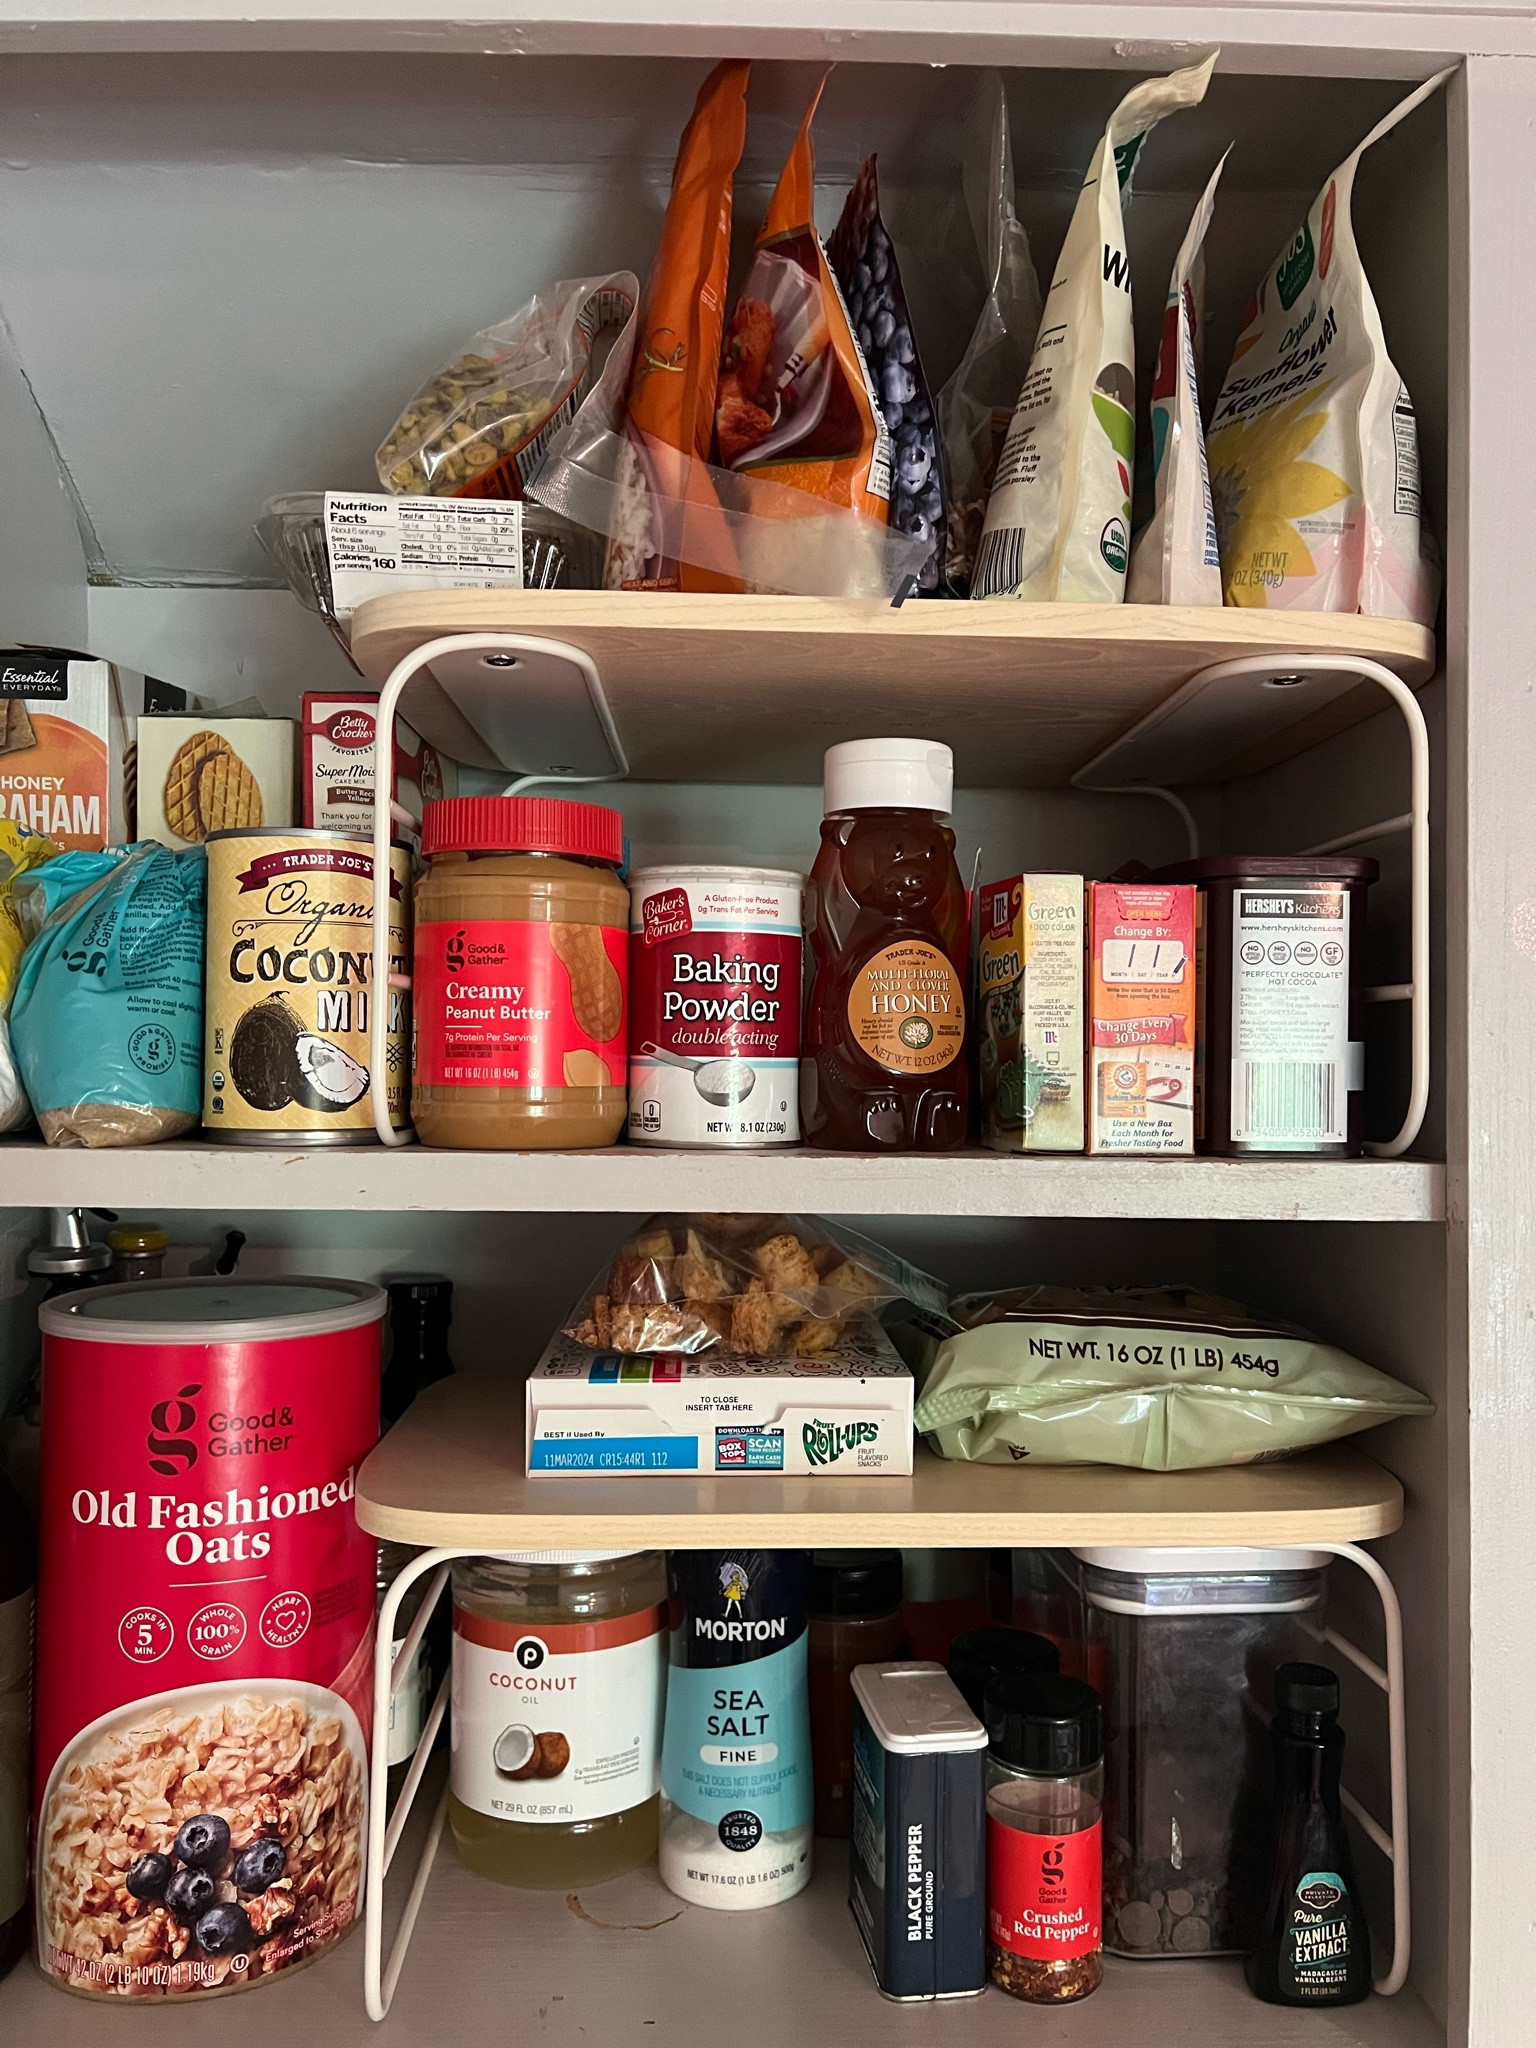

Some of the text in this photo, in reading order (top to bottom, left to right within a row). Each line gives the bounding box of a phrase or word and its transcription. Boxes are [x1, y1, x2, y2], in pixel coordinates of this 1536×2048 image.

[1219, 305, 1338, 399] Sunflower
[1216, 362, 1327, 421] Kernels
[1020, 464, 1037, 473] Fluff
[1010, 475, 1035, 485] parsley
[330, 501, 387, 512] Nutrition
[330, 512, 367, 524] Facts
[333, 553, 370, 562] Calories
[372, 558, 396, 569] 160
[334, 563, 372, 571] per serving
[1234, 569, 1284, 588] OZ (340g)
[2, 668, 59, 684] Essential
[340, 716, 368, 730] Betty
[332, 726, 373, 739] Crocker
[1, 776, 65, 791] HONEY
[347, 795, 371, 803] Yellow
[283, 853, 373, 872] TRADER JOE'S
[265, 880, 373, 947] Organ
[644, 894, 685, 919] Baker's
[697, 905, 707, 914] 0g
[744, 906, 755, 914] Per
[756, 907, 779, 917] Serving
[1028, 902, 1076, 920] Green
[1126, 909, 1163, 917] OPEN HERE
[1245, 898, 1341, 917] HERSHEY'S Kitchens
[96, 909, 120, 948] Gather
[644, 923, 687, 945] Corner
[1030, 923, 1076, 931] FOOD COLOR
[1113, 925, 1172, 939] Change BY:
[1240, 924, 1343, 933] www.hersheyskitchens.com
[1325, 947, 1338, 955] GF
[229, 938, 406, 985] COCONT
[468, 955, 504, 965] Gather
[983, 950, 1020, 982] Green
[673, 953, 780, 992] Baking
[867, 968, 951, 980] MULTI-FLORAL
[446, 982, 524, 1004] Creamy
[871, 980, 949, 992] AND CLOVER
[127, 995, 150, 1004] Allow
[163, 1000, 177, 1008] cool
[663, 991, 780, 1022] Powder
[871, 993, 952, 1014] HONEY
[317, 990, 406, 1033] MIK
[446, 1005, 551, 1020] Peanut Butter
[1098, 1017, 1171, 1034] Change Every
[445, 1033, 538, 1043] 7g Protein Per Serving
[671, 1026, 779, 1050] double acting
[1115, 1031, 1157, 1045] 30 Days
[1133, 1129, 1160, 1137] Month
[1162, 1129, 1174, 1137] for
[1101, 1139, 1184, 1148] Fresher Tasting Food
[1028, 1338, 1279, 1378] NET WT. 16 OZ (1 LB) 454g
[700, 1396, 739, 1404] TO CLOSE
[208, 1406, 294, 1434] Good &
[812, 1418, 836, 1429] FRUIT
[208, 1433, 290, 1458] Gather
[718, 1442, 742, 1453] BOX
[748, 1438, 782, 1448] SCAN
[802, 1421, 879, 1467] ROLL-UPS
[544, 1452, 668, 1467] 11MAR2024 CR15:44R1 112
[722, 1449, 746, 1458] TOPS
[71, 1465, 355, 1530] Old Fashioned
[166, 1530, 271, 1566] Oats
[271, 1597, 302, 1613] HEART
[125, 1612, 167, 1631] COOKS IN
[200, 1608, 236, 1623] WHOLE
[137, 1624, 153, 1646] 5
[195, 1623, 240, 1641] 100%
[266, 1623, 304, 1643] HEALTHY
[695, 1616, 786, 1642] MORTON
[134, 1647, 156, 1655] MIN.
[200, 1641, 233, 1656] GRAIN
[489, 1672, 578, 1691] COCONUT
[521, 1696, 539, 1705] OIL
[713, 1689, 765, 1711] SEA
[707, 1713, 770, 1737] SALT
[720, 1750, 757, 1762] FINE
[723, 1813, 756, 1825] TRUSTED
[724, 1825, 758, 1836] 1848
[725, 1838, 756, 1850] QUALITY
[907, 1823, 923, 1941] BLACK PEPPER
[925, 1871, 934, 1940] PURE GROUND
[1023, 1906, 1083, 1924] Crushed
[1294, 1909, 1323, 1923] Pure
[293, 1918, 323, 1938] Serving
[1014, 1920, 1042, 1939] Red
[1044, 1922, 1090, 1942] Pepper
[1295, 1921, 1347, 1946] VANILLA
[265, 1923, 334, 1962] Enlarged to Show
[1295, 1937, 1348, 1962] EXTRACT
